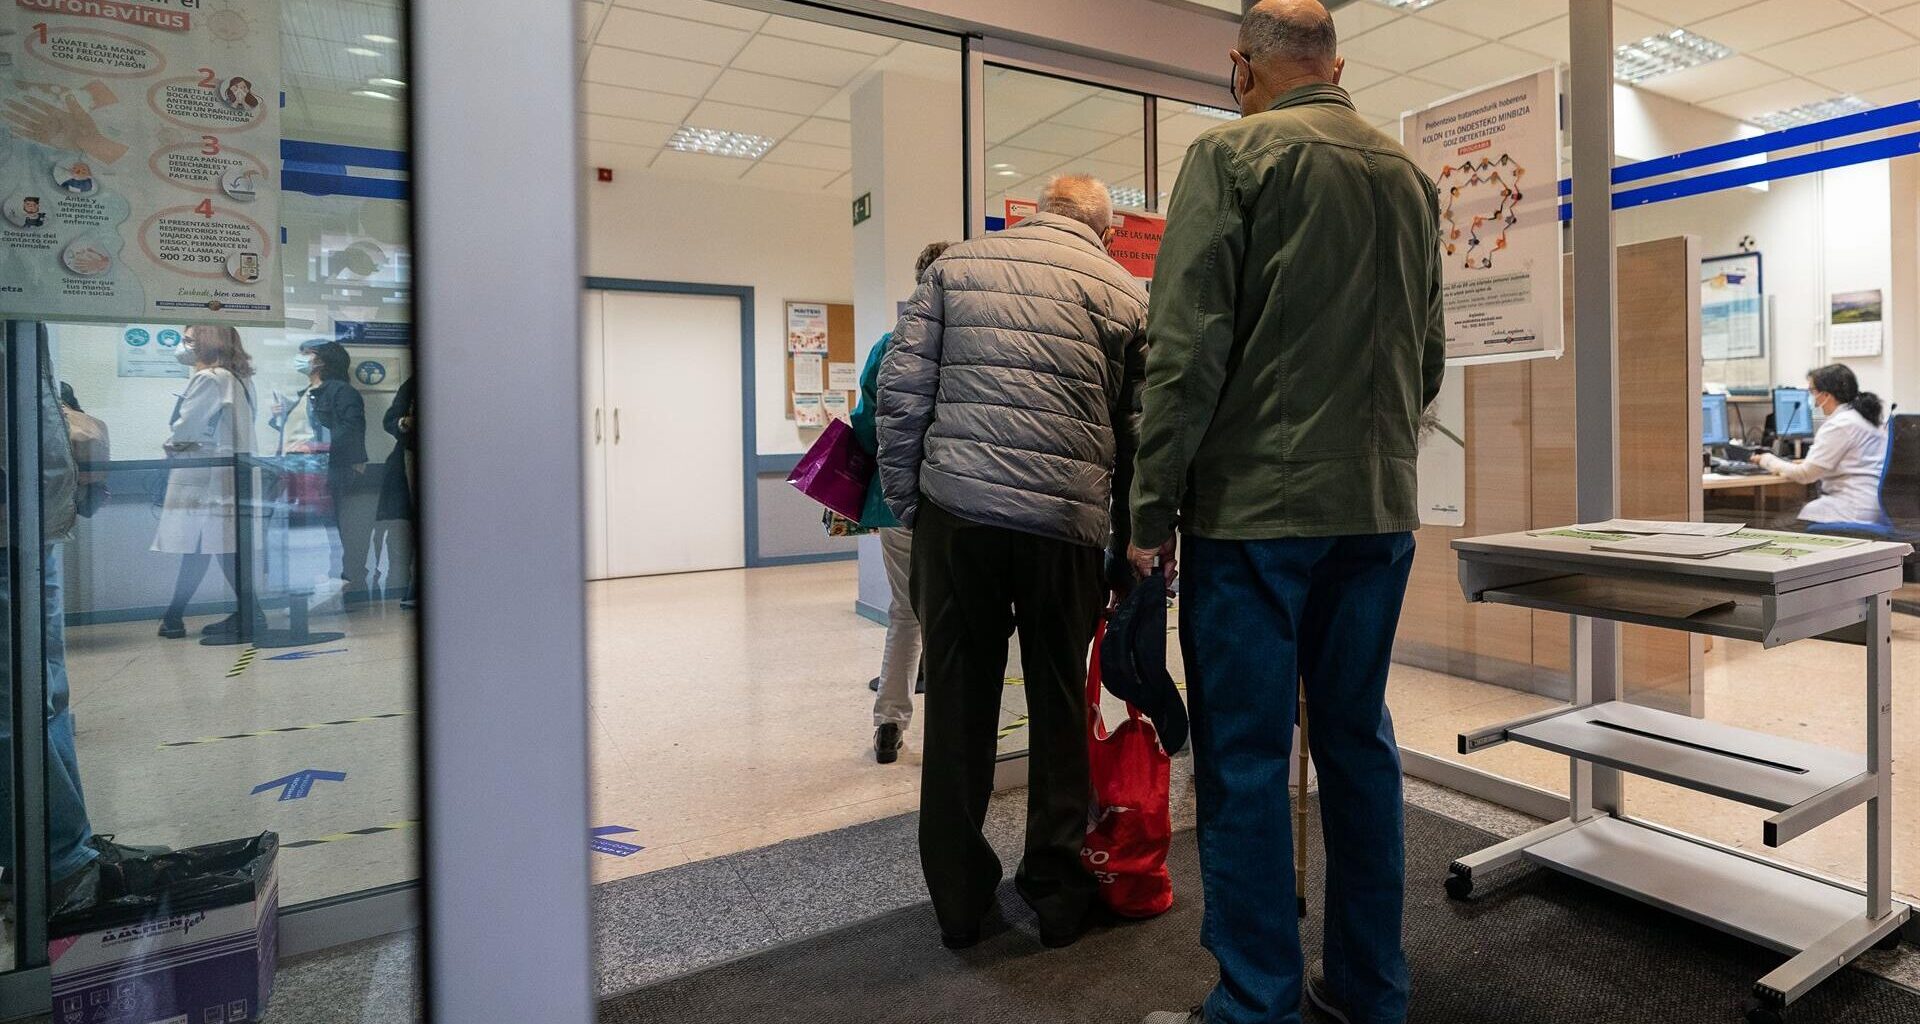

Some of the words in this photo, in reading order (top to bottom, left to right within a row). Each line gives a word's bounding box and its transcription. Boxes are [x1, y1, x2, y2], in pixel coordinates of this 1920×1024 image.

[26, 0, 184, 28] coronavirus
[32, 22, 48, 44] 1
[51, 37, 88, 48] LÁVATE
[91, 42, 108, 51] LAS
[111, 46, 147, 56] MANOS
[51, 44, 74, 53] CON
[76, 47, 135, 61] FRECUENCIA
[52, 51, 74, 60] CON
[76, 54, 104, 65] AGUA
[114, 58, 146, 69] JABÓN
[198, 68, 216, 88] 2
[166, 97, 214, 107] ANTEBRAZO
[167, 109, 190, 117] TOSER
[200, 113, 250, 123] ESTORNUDAR
[1421, 132, 1444, 144] KOLON
[1444, 129, 1456, 139] ETA
[1456, 116, 1498, 135] ONDESTEKO
[1498, 105, 1531, 123] MINBIZIA
[1443, 138, 1458, 148] GOIZ
[1459, 124, 1506, 143] DETEKTATZEKO
[201, 135, 220, 155] 3
[168, 153, 200, 163] UTILIZA
[168, 160, 220, 170] DESECHABLES
[168, 172, 208, 181] PAPELERA
[60, 206, 95, 215] atender
[195, 198, 214, 218] 4
[63, 218, 100, 226] enferma
[74, 213, 110, 222] persona
[168, 219, 210, 228] PRESENTAS
[159, 225, 218, 235] RESPIRATORIOS
[1130, 230, 1143, 239] LAS
[159, 232, 192, 240] VIAJADO
[10, 242, 51, 250] animales
[191, 240, 236, 249] PERMANECE
[159, 253, 180, 261] 900
[182, 254, 195, 262] 20
[198, 255, 211, 263] 30
[213, 255, 226, 264] 50
[1130, 250, 1140, 260] DE
[1141, 252, 1157, 261] ENT
[61, 277, 97, 286] Siempre
[98, 280, 115, 288] que
[0, 285, 23, 293] etza
[82, 284, 111, 292] manos
[214, 288, 229, 298] bien
